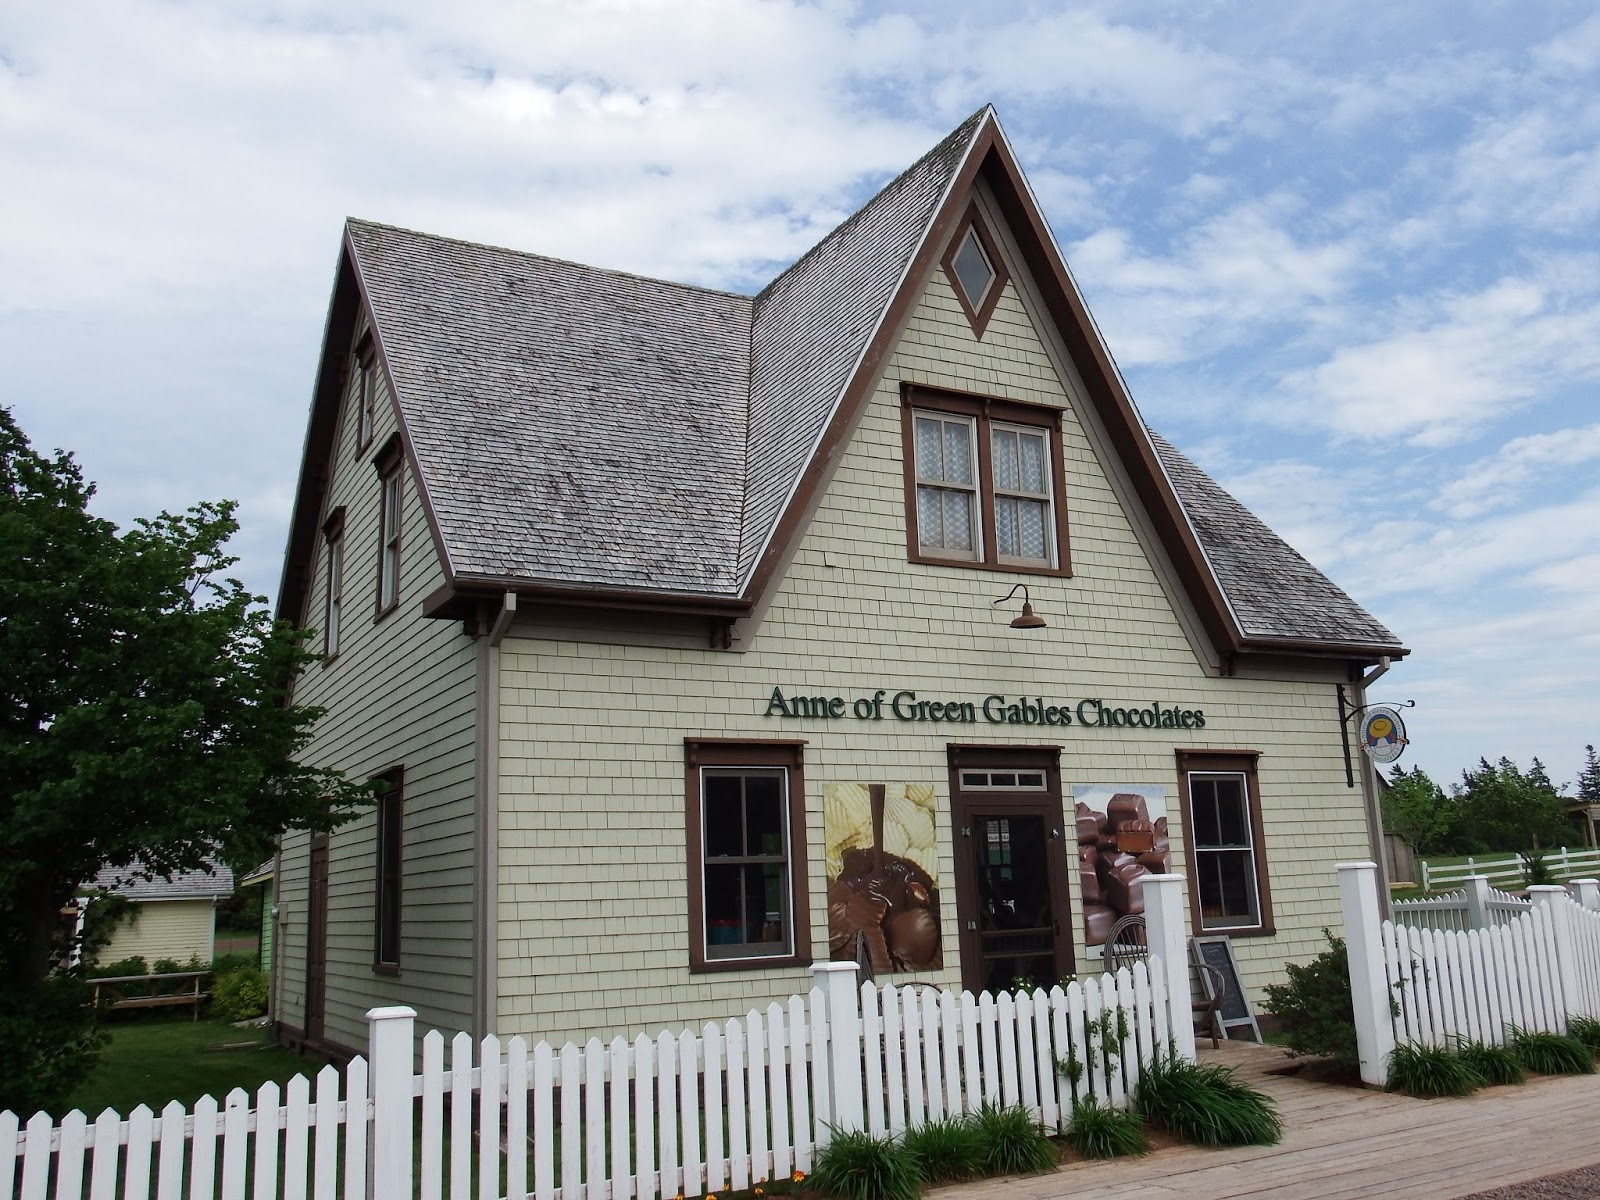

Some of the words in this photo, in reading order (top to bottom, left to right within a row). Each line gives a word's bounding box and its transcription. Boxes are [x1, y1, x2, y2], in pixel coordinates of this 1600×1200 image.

[764, 686, 846, 718] Anne
[853, 690, 886, 721] of
[892, 691, 977, 723] Green
[982, 695, 1072, 725] Gables
[1076, 698, 1206, 728] Chocolates
[1367, 748, 1400, 762] Chocolates
